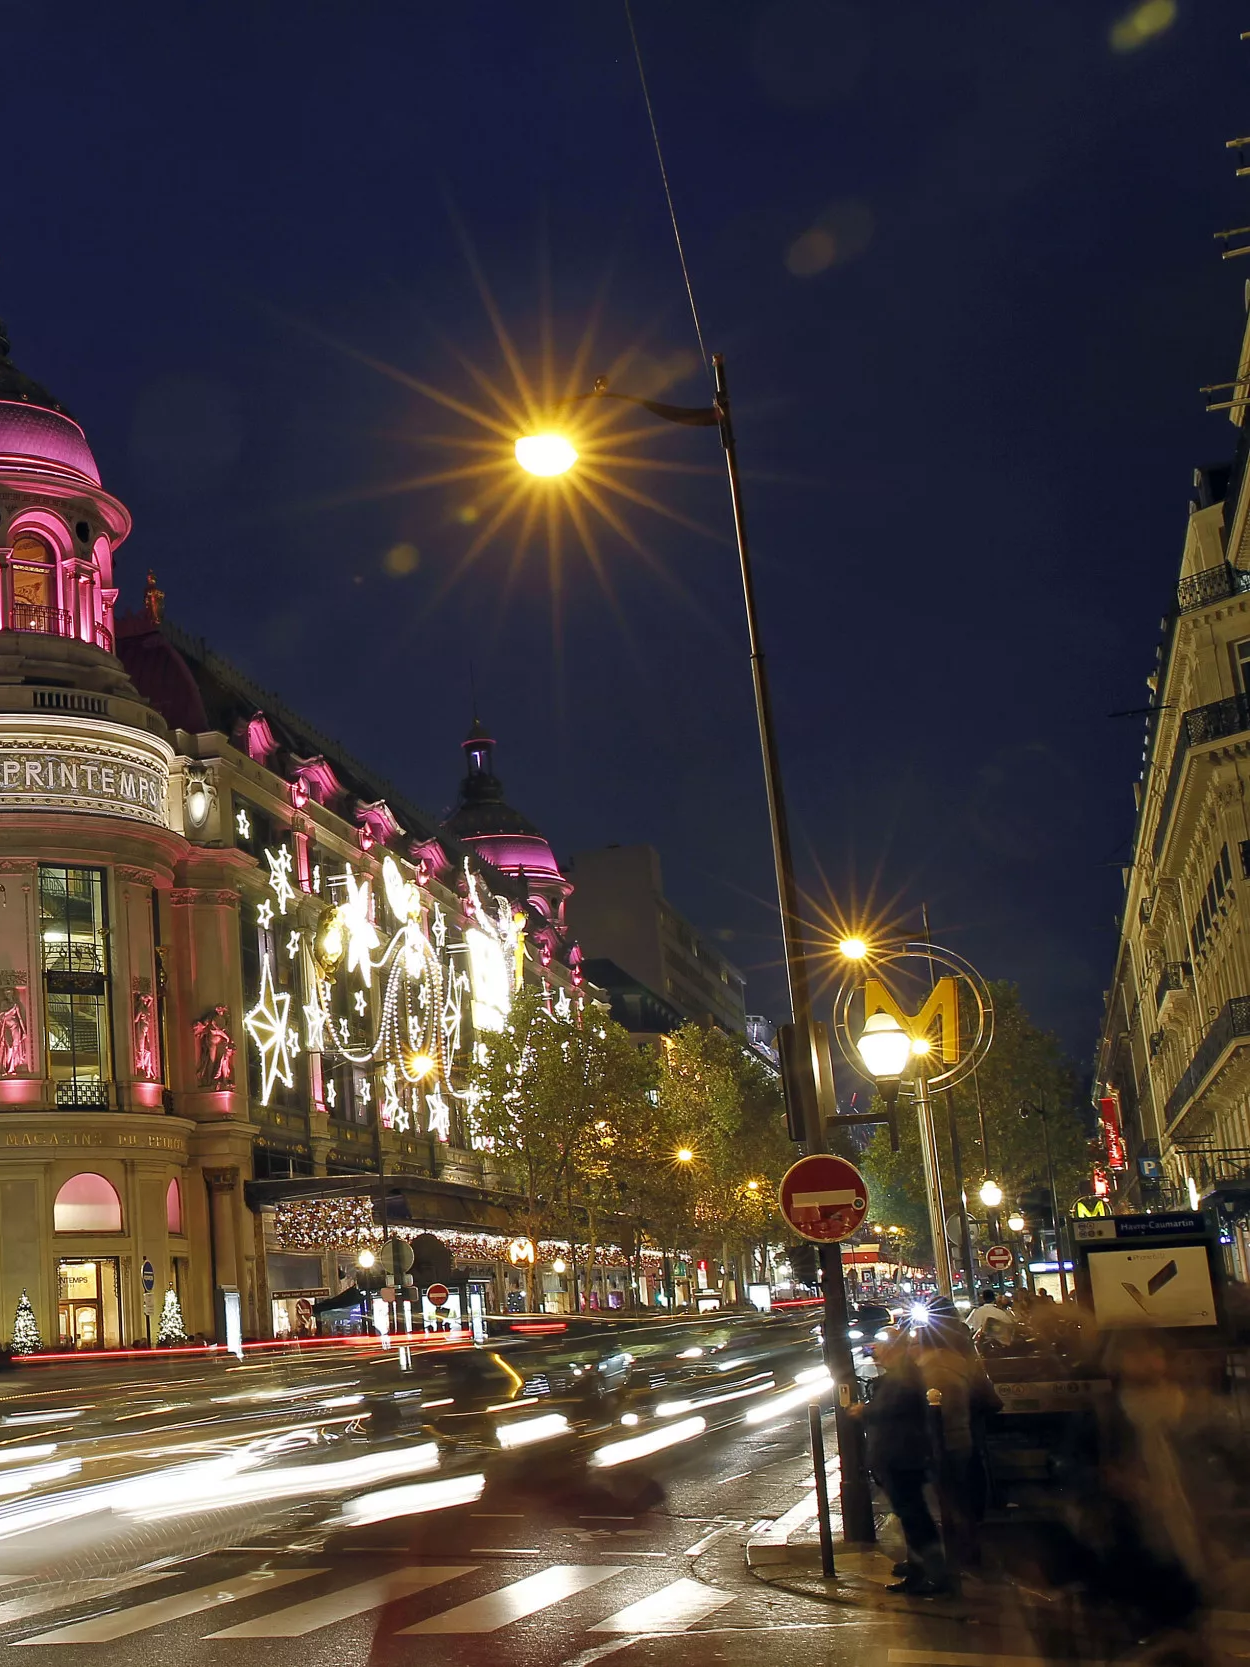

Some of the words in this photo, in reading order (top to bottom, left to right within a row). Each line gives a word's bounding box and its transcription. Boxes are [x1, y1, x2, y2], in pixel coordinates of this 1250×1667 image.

[3, 760, 158, 808] PRINTEMPS
[864, 976, 960, 1065] M
[5, 1132, 102, 1147] MAGASINS
[118, 1133, 137, 1146] DU
[1143, 1160, 1155, 1175] P
[1120, 1218, 1195, 1232] Havre-Caumartin
[510, 1241, 535, 1265] M
